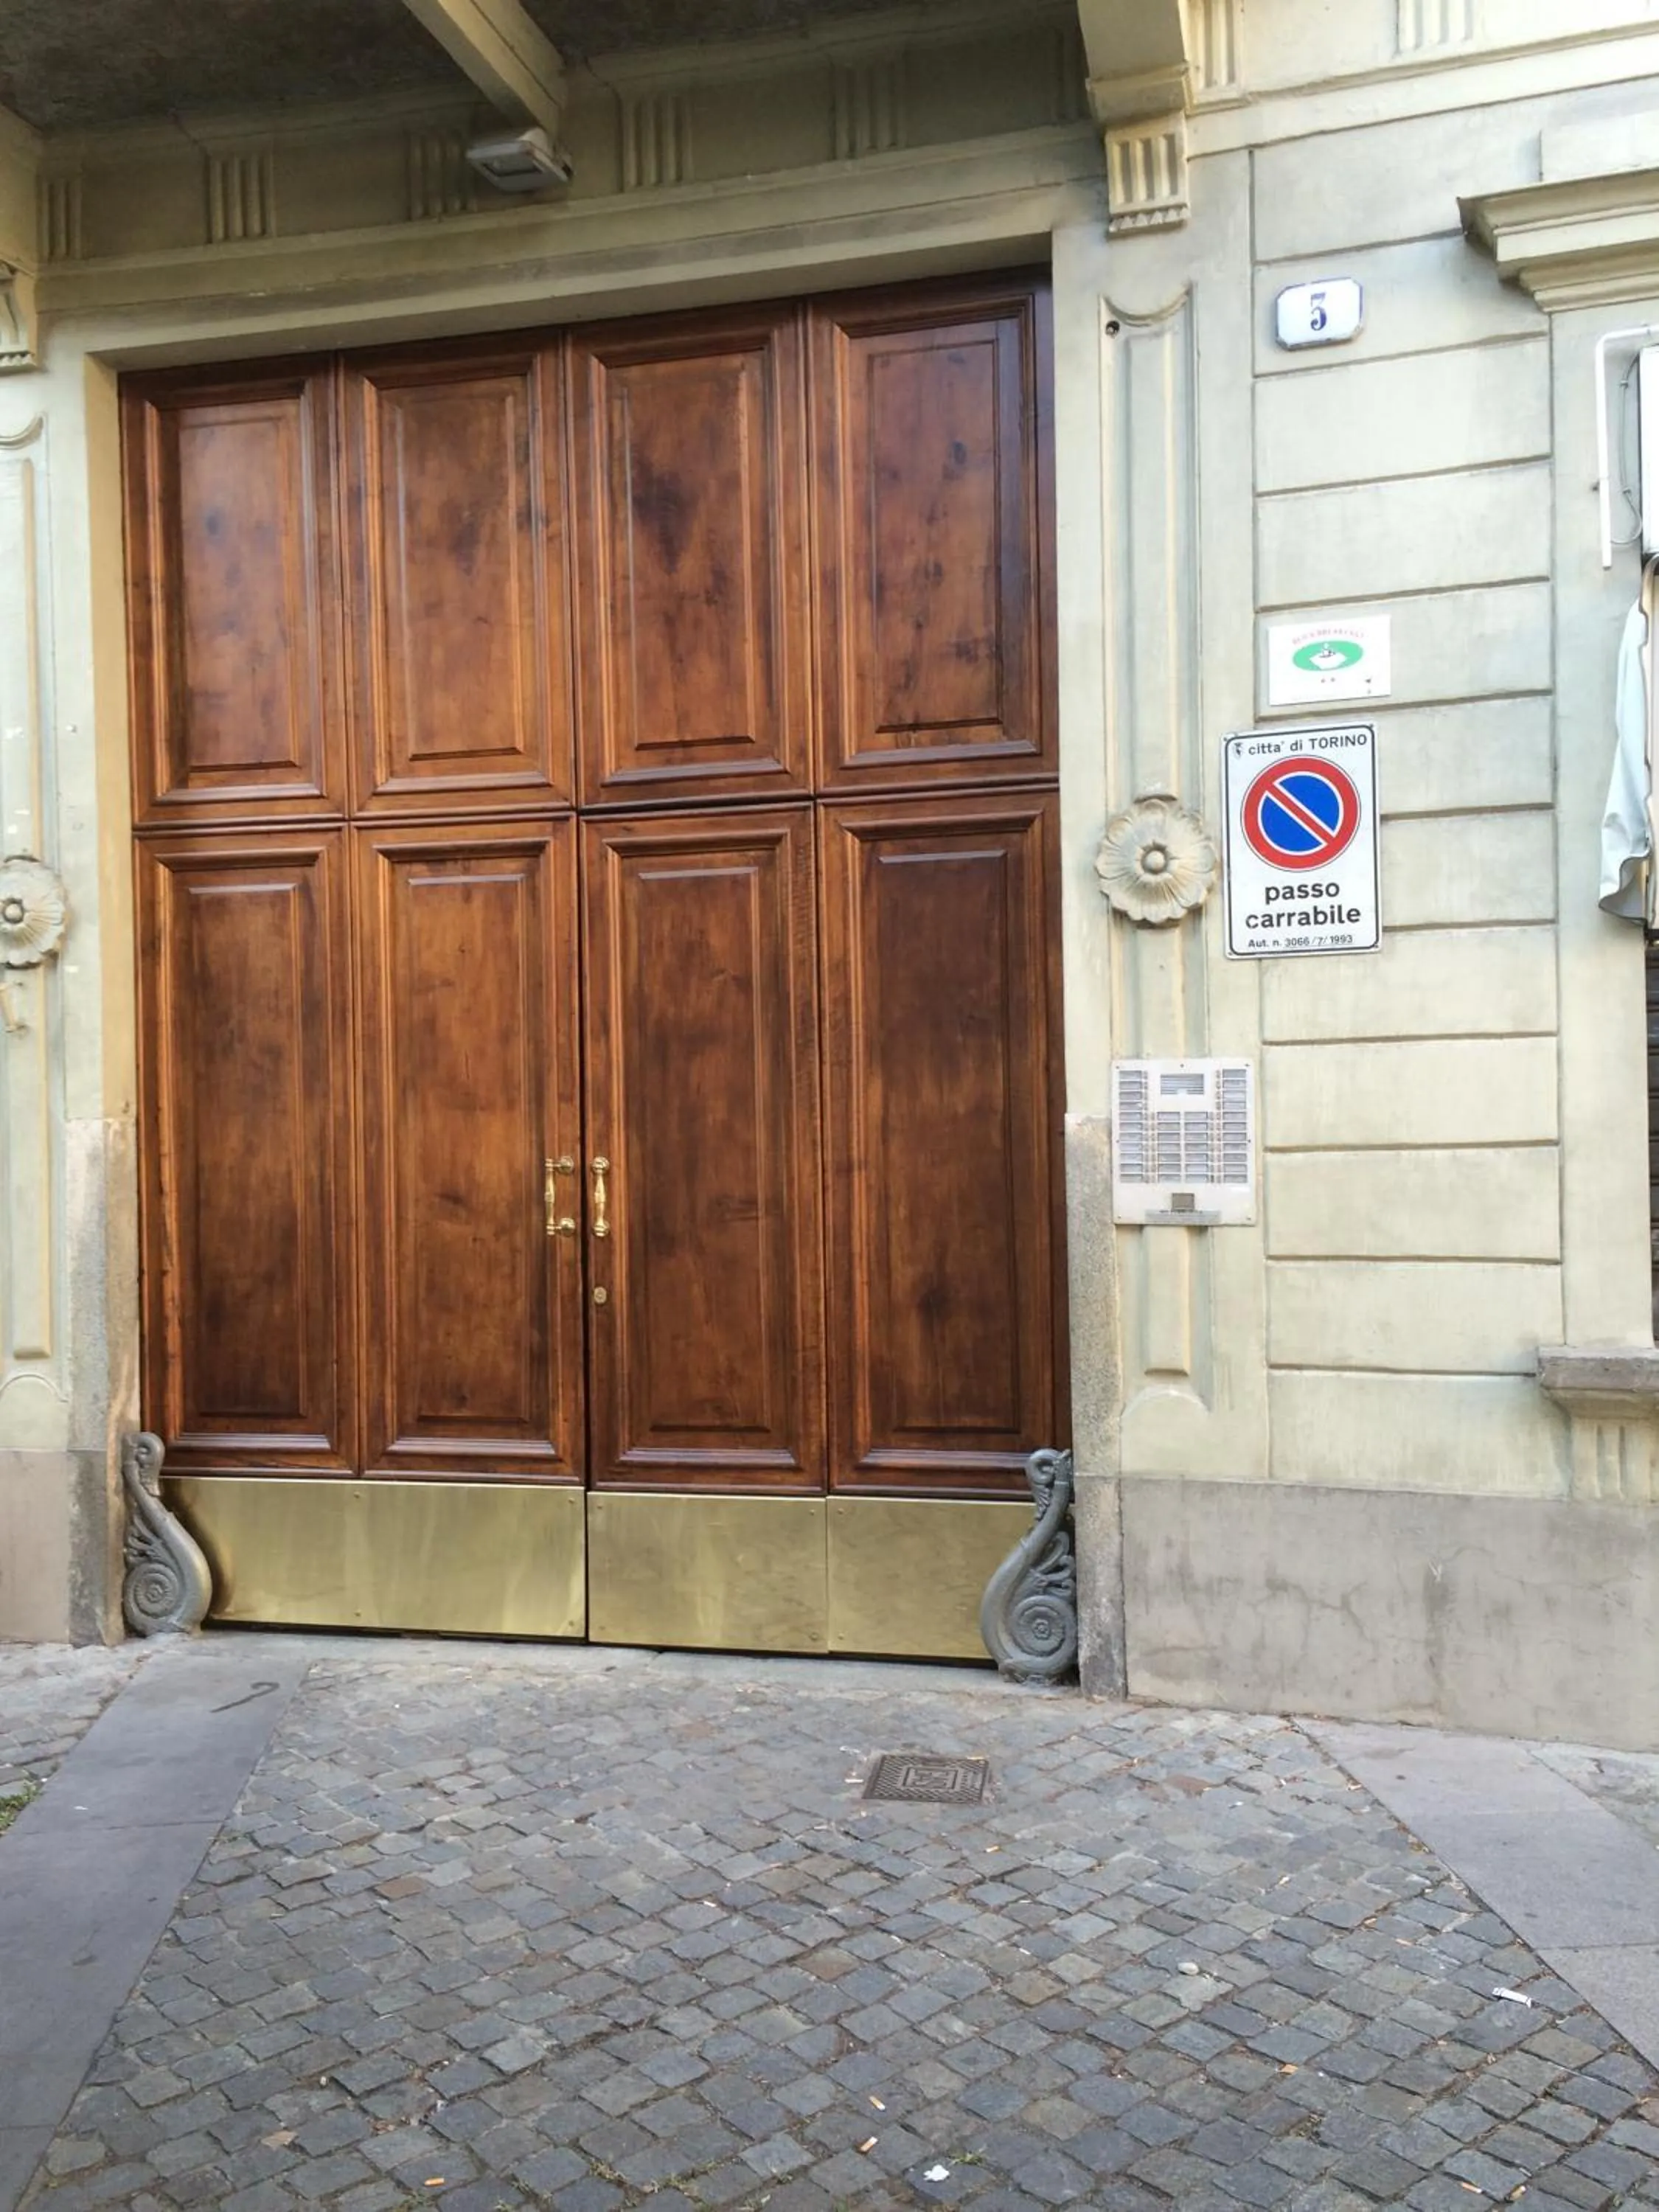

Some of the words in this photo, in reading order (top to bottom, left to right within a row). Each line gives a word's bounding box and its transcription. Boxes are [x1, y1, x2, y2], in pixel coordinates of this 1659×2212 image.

[1290, 739, 1303, 751] di
[1309, 734, 1367, 750] TORINO
[1265, 882, 1340, 905] passo
[1245, 904, 1361, 929] carrabile
[1248, 939, 1268, 947] Aut.
